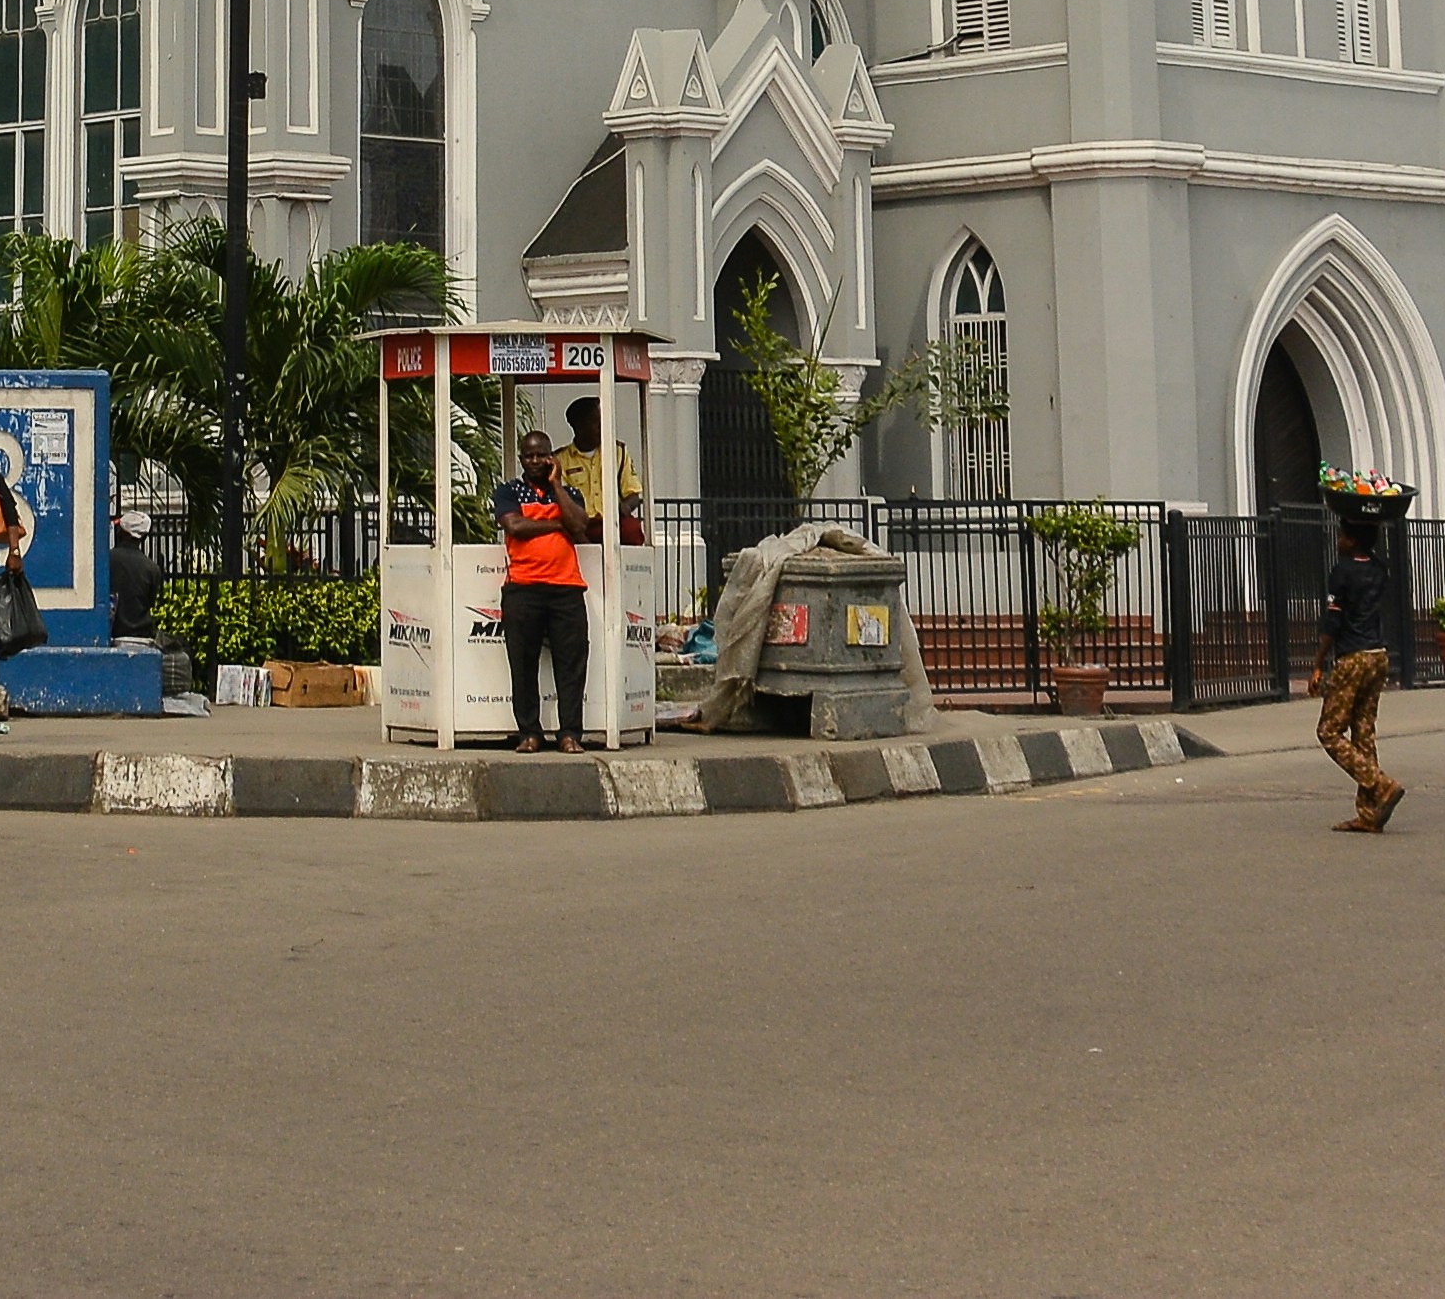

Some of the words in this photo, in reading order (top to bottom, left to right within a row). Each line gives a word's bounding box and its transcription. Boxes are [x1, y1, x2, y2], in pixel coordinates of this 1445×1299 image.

[397, 346, 422, 373] POLICE
[492, 356, 546, 372] 07061560290
[568, 346, 605, 367] 206
[389, 623, 431, 644] MIKANO
[466, 694, 477, 703] Do
[478, 694, 490, 703] not
